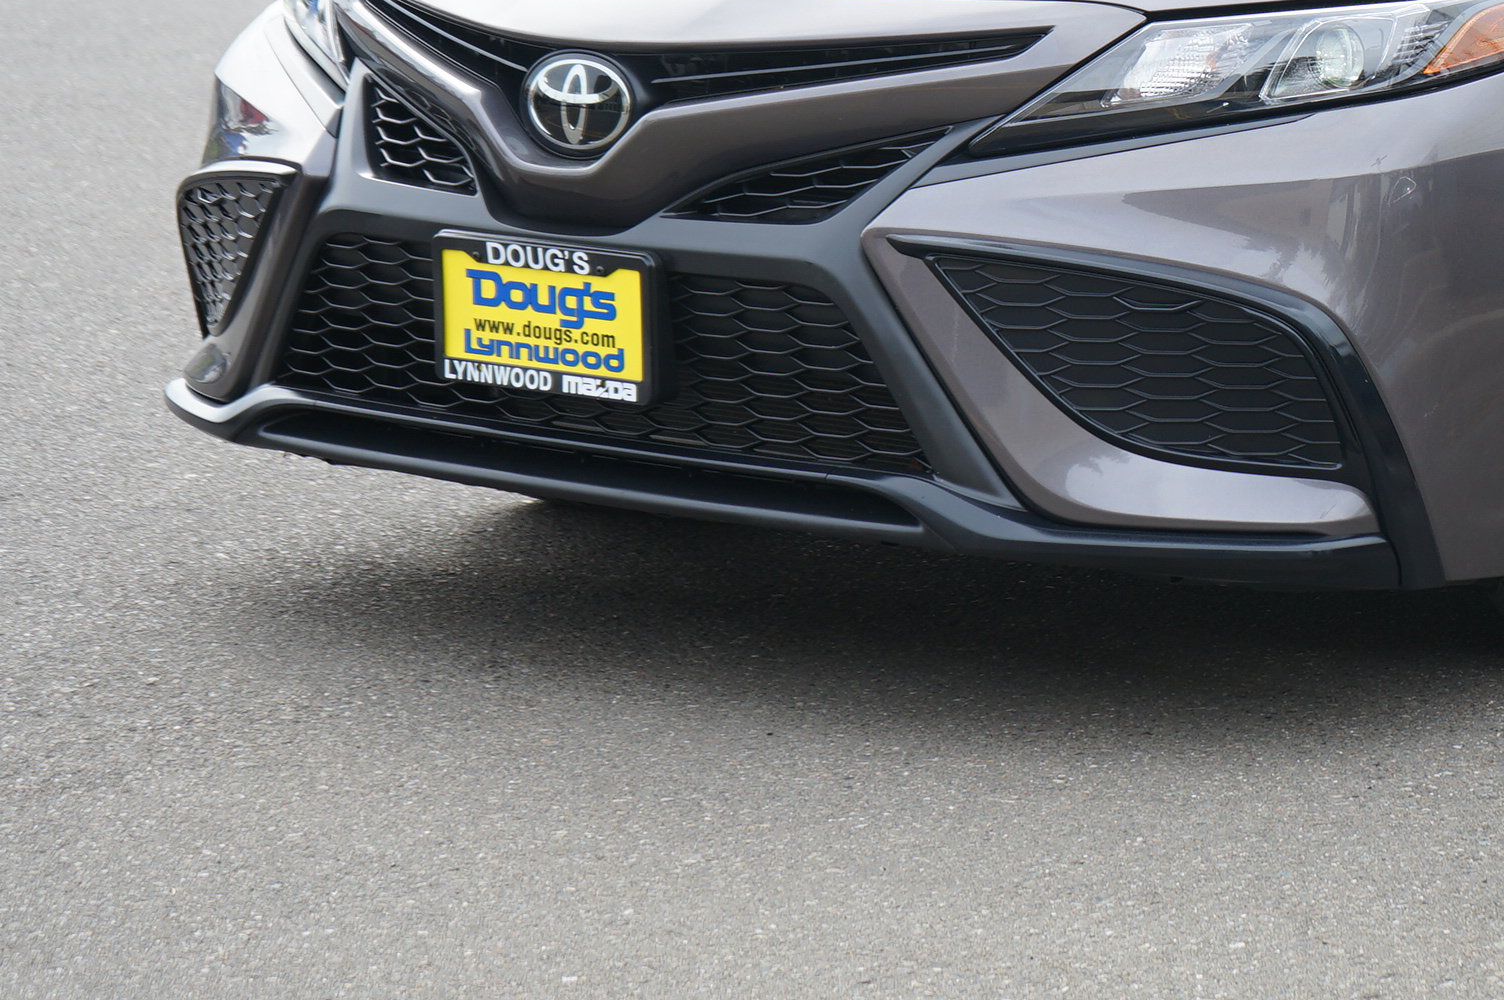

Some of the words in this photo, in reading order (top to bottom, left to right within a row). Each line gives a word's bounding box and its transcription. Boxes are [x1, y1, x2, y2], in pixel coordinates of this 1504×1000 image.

[485, 241, 590, 275] DOUG'S
[464, 328, 625, 373] Lynnwood
[473, 317, 616, 349] www.dougs.com
[444, 358, 552, 391] LYNNWOOD
[562, 374, 638, 402] mazda
